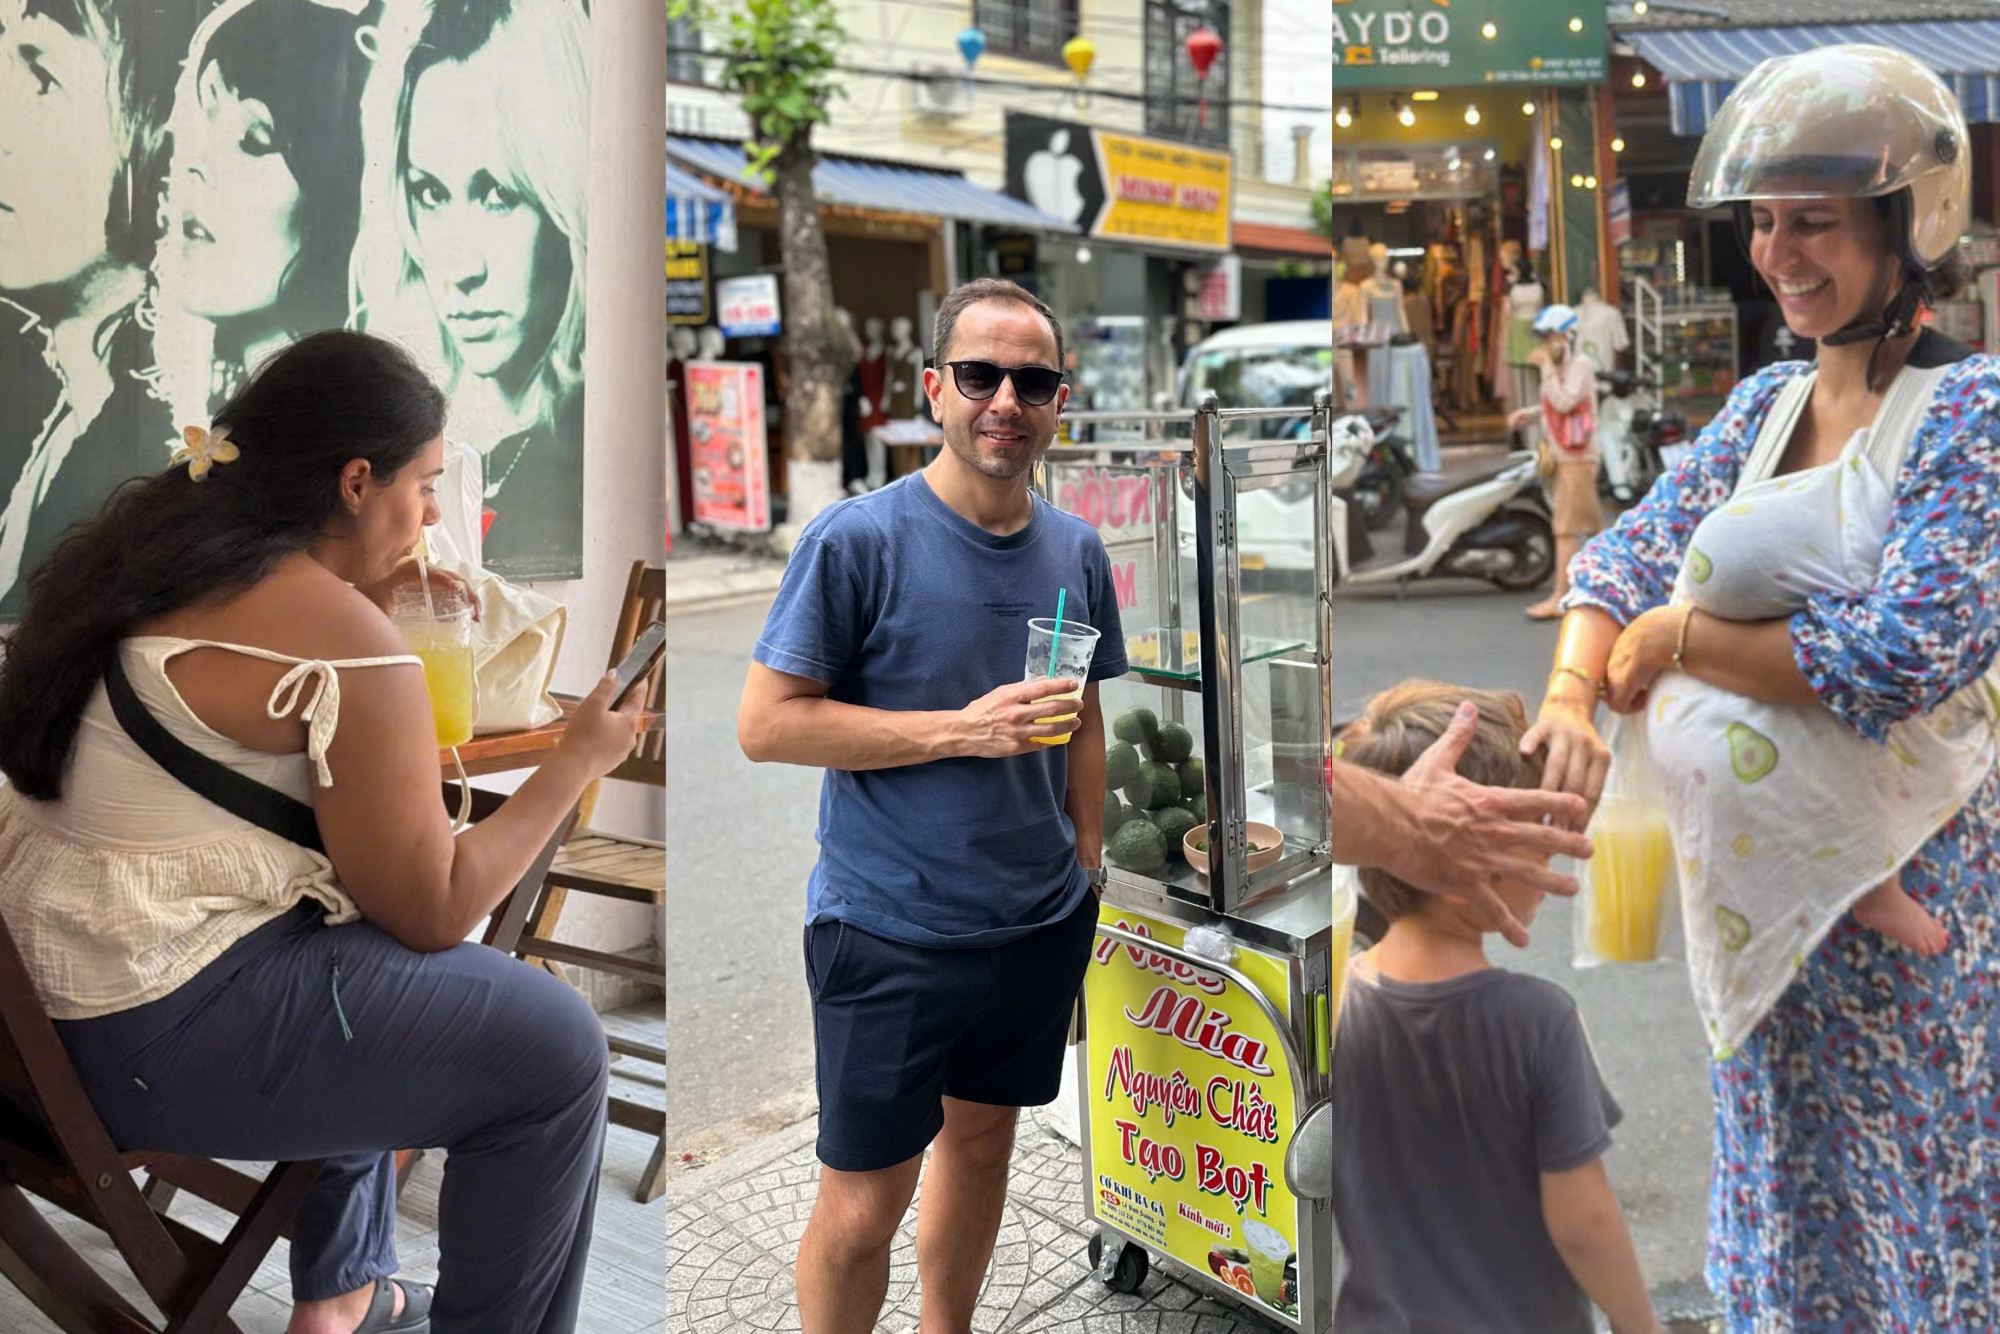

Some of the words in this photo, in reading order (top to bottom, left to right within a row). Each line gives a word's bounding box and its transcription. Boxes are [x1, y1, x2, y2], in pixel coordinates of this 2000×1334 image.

[1379, 47, 1450, 67] Tailoring
[1124, 986, 1274, 1077] Mía
[1105, 1046, 1201, 1129] Nguyên
[1206, 1074, 1279, 1143] Chất
[1114, 1180, 1132, 1200] KHÍ
[1134, 1192, 1148, 1209] BA
[1151, 1201, 1165, 1217] GÀ
[1115, 1119, 1186, 1184] Tạo
[1196, 1142, 1274, 1215] Bọt
[1178, 1203, 1202, 1225] Kính
[1205, 1218, 1224, 1235] mời
